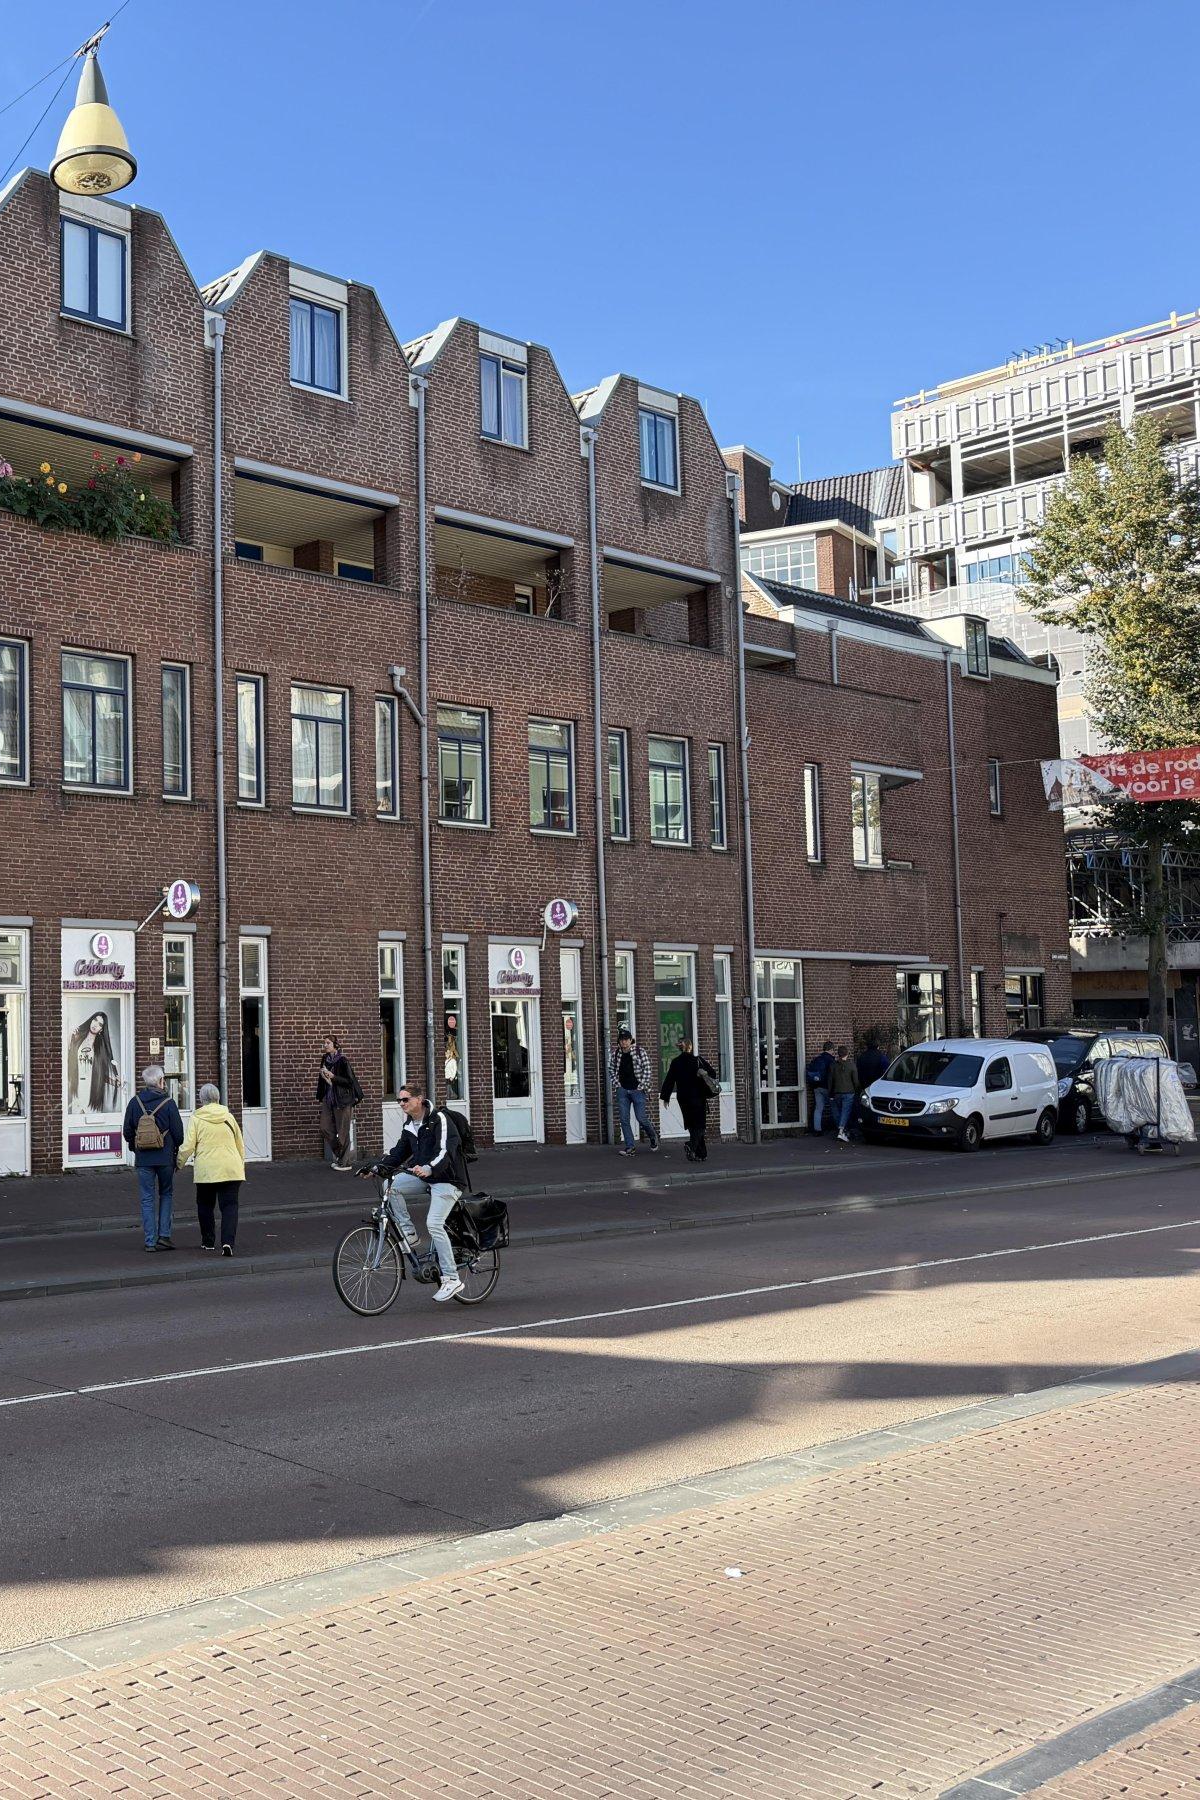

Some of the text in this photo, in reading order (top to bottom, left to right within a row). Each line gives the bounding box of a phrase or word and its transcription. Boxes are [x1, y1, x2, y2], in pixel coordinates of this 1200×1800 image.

[1132, 758, 1160, 775] de
[1174, 774, 1195, 795] je
[74, 959, 125, 980] Celebrity
[80, 1134, 110, 1151] PRUIKEN
